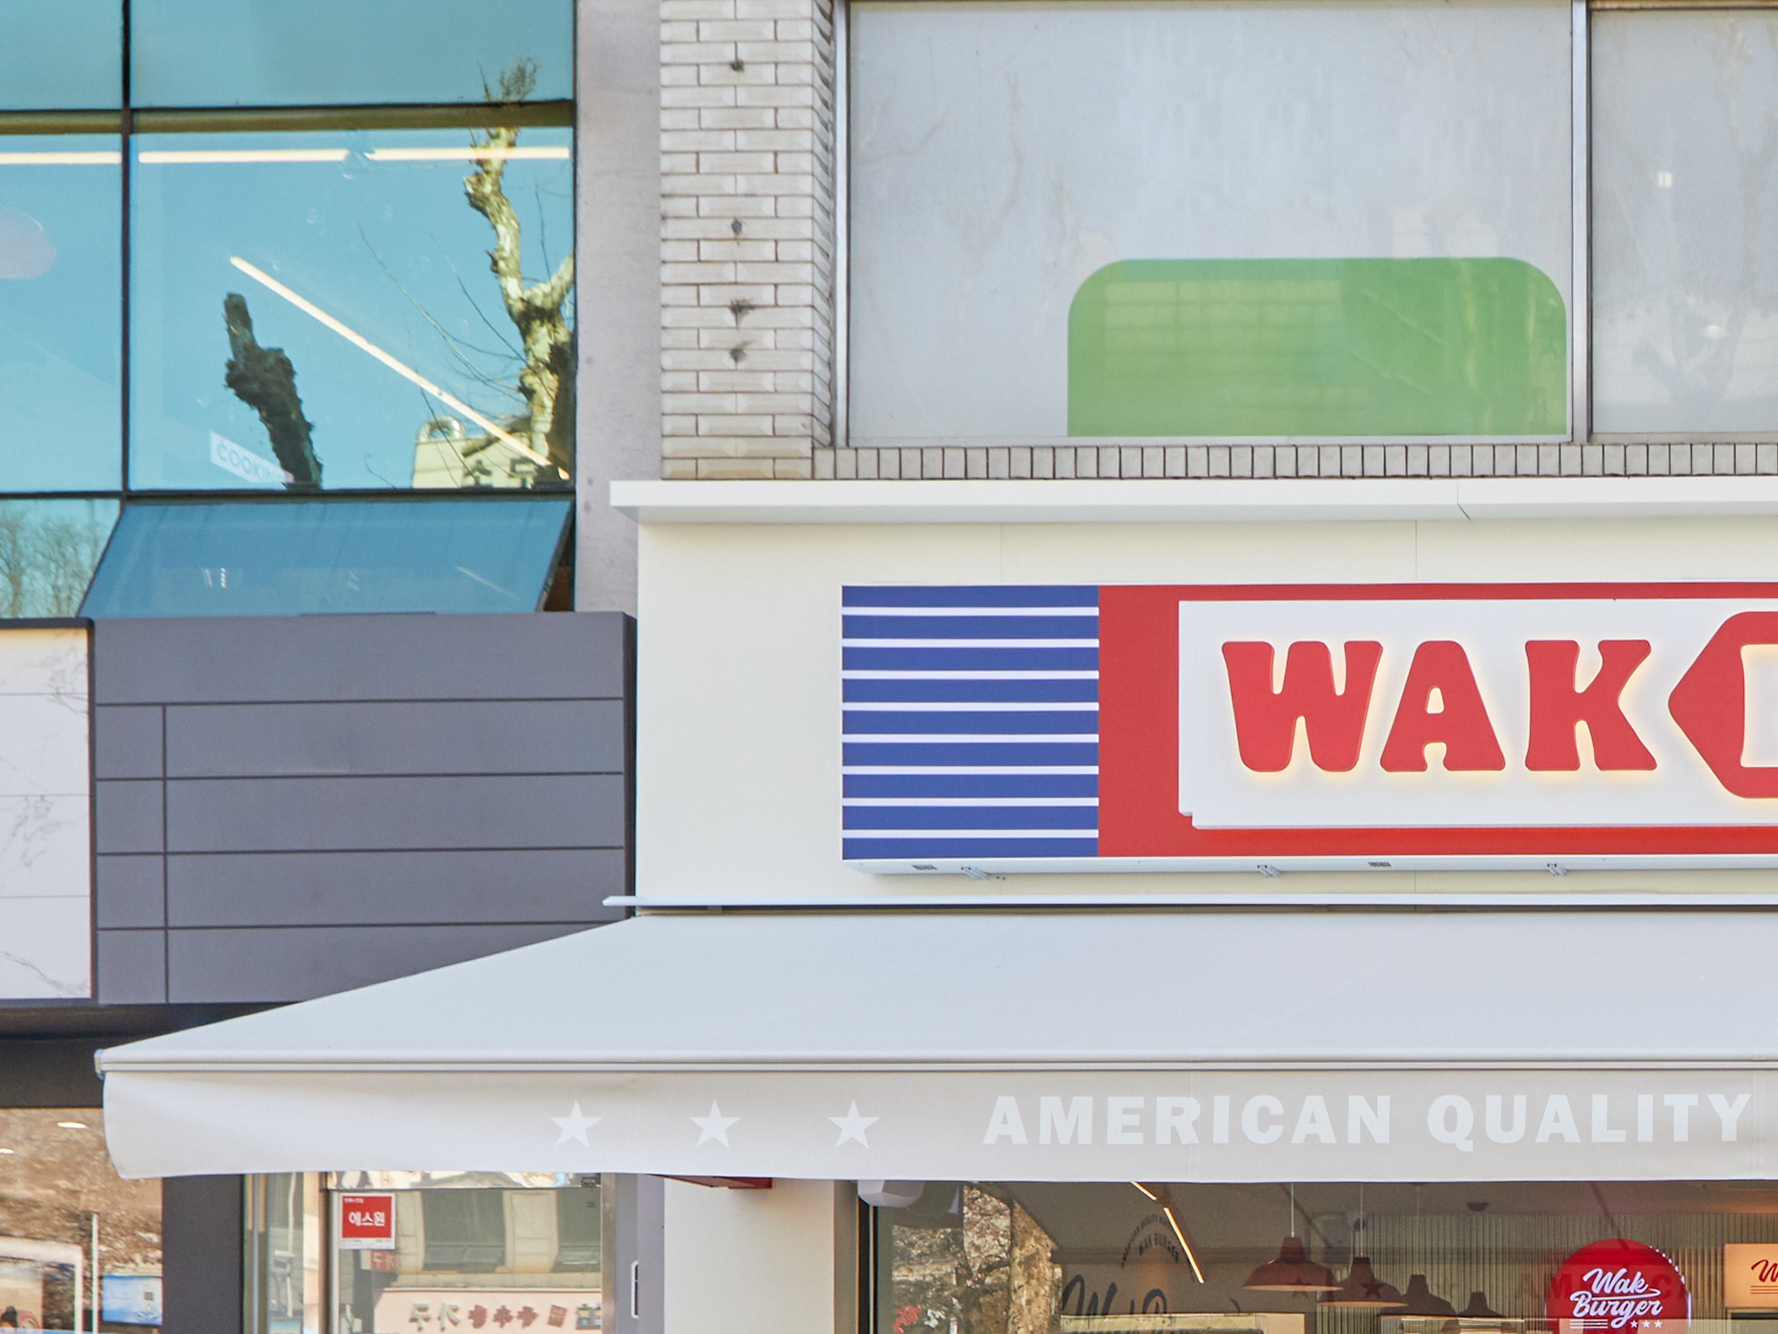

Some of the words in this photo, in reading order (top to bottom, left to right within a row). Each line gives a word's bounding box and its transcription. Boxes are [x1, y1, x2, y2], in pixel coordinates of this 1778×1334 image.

[1221, 639, 1655, 774] WAK
[983, 1095, 1393, 1146] AMERICAN
[1425, 1093, 1755, 1150] QUALITY
[349, 1211, 385, 1227] 에스원
[1583, 1267, 1649, 1294] Wak
[1569, 1290, 1663, 1329] Burger
